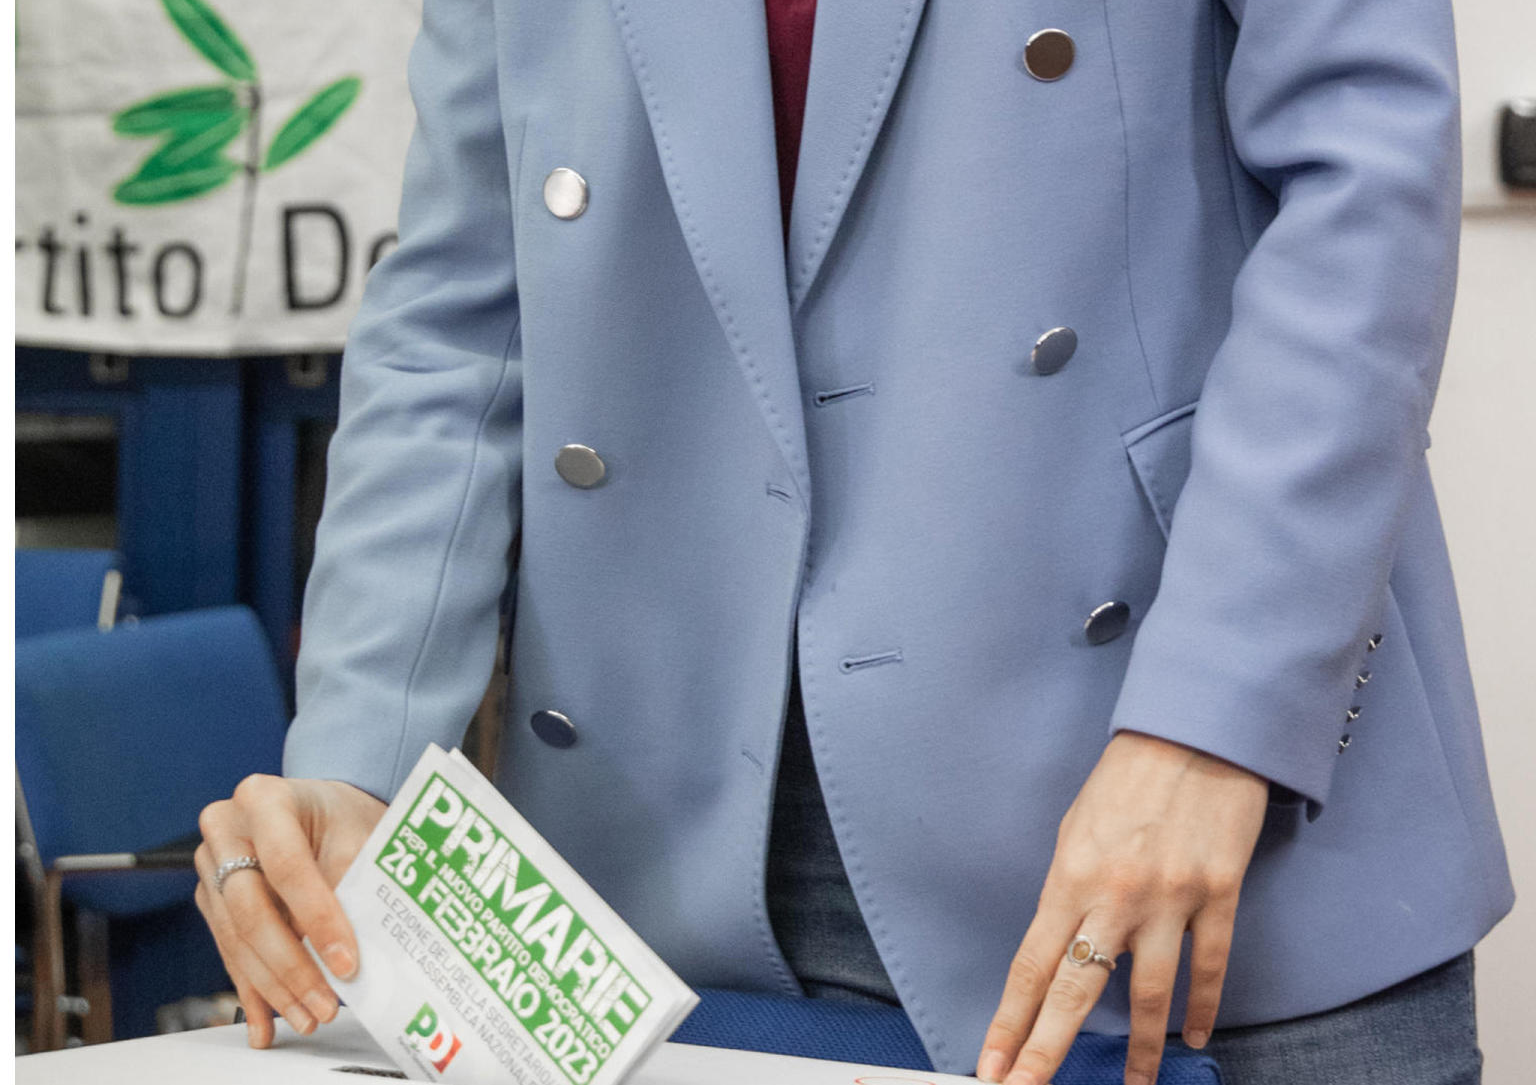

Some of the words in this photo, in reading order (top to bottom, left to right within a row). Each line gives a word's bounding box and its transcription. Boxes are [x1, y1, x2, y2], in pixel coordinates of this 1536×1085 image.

[15, 212, 202, 318] tito
[281, 204, 399, 312] D
[376, 883, 431, 942] ELEZIONE
[379, 838, 418, 887] 26
[417, 874, 542, 1020] FEBBRAIO
[533, 1007, 599, 1085] 2023
[397, 824, 428, 857] PER
[436, 862, 484, 914] NUOVO
[478, 907, 532, 967] PARTITO
[527, 960, 611, 1060] DEMOCRATICO
[407, 776, 649, 1046] PRIMARIE
[404, 1001, 463, 1074] PD
